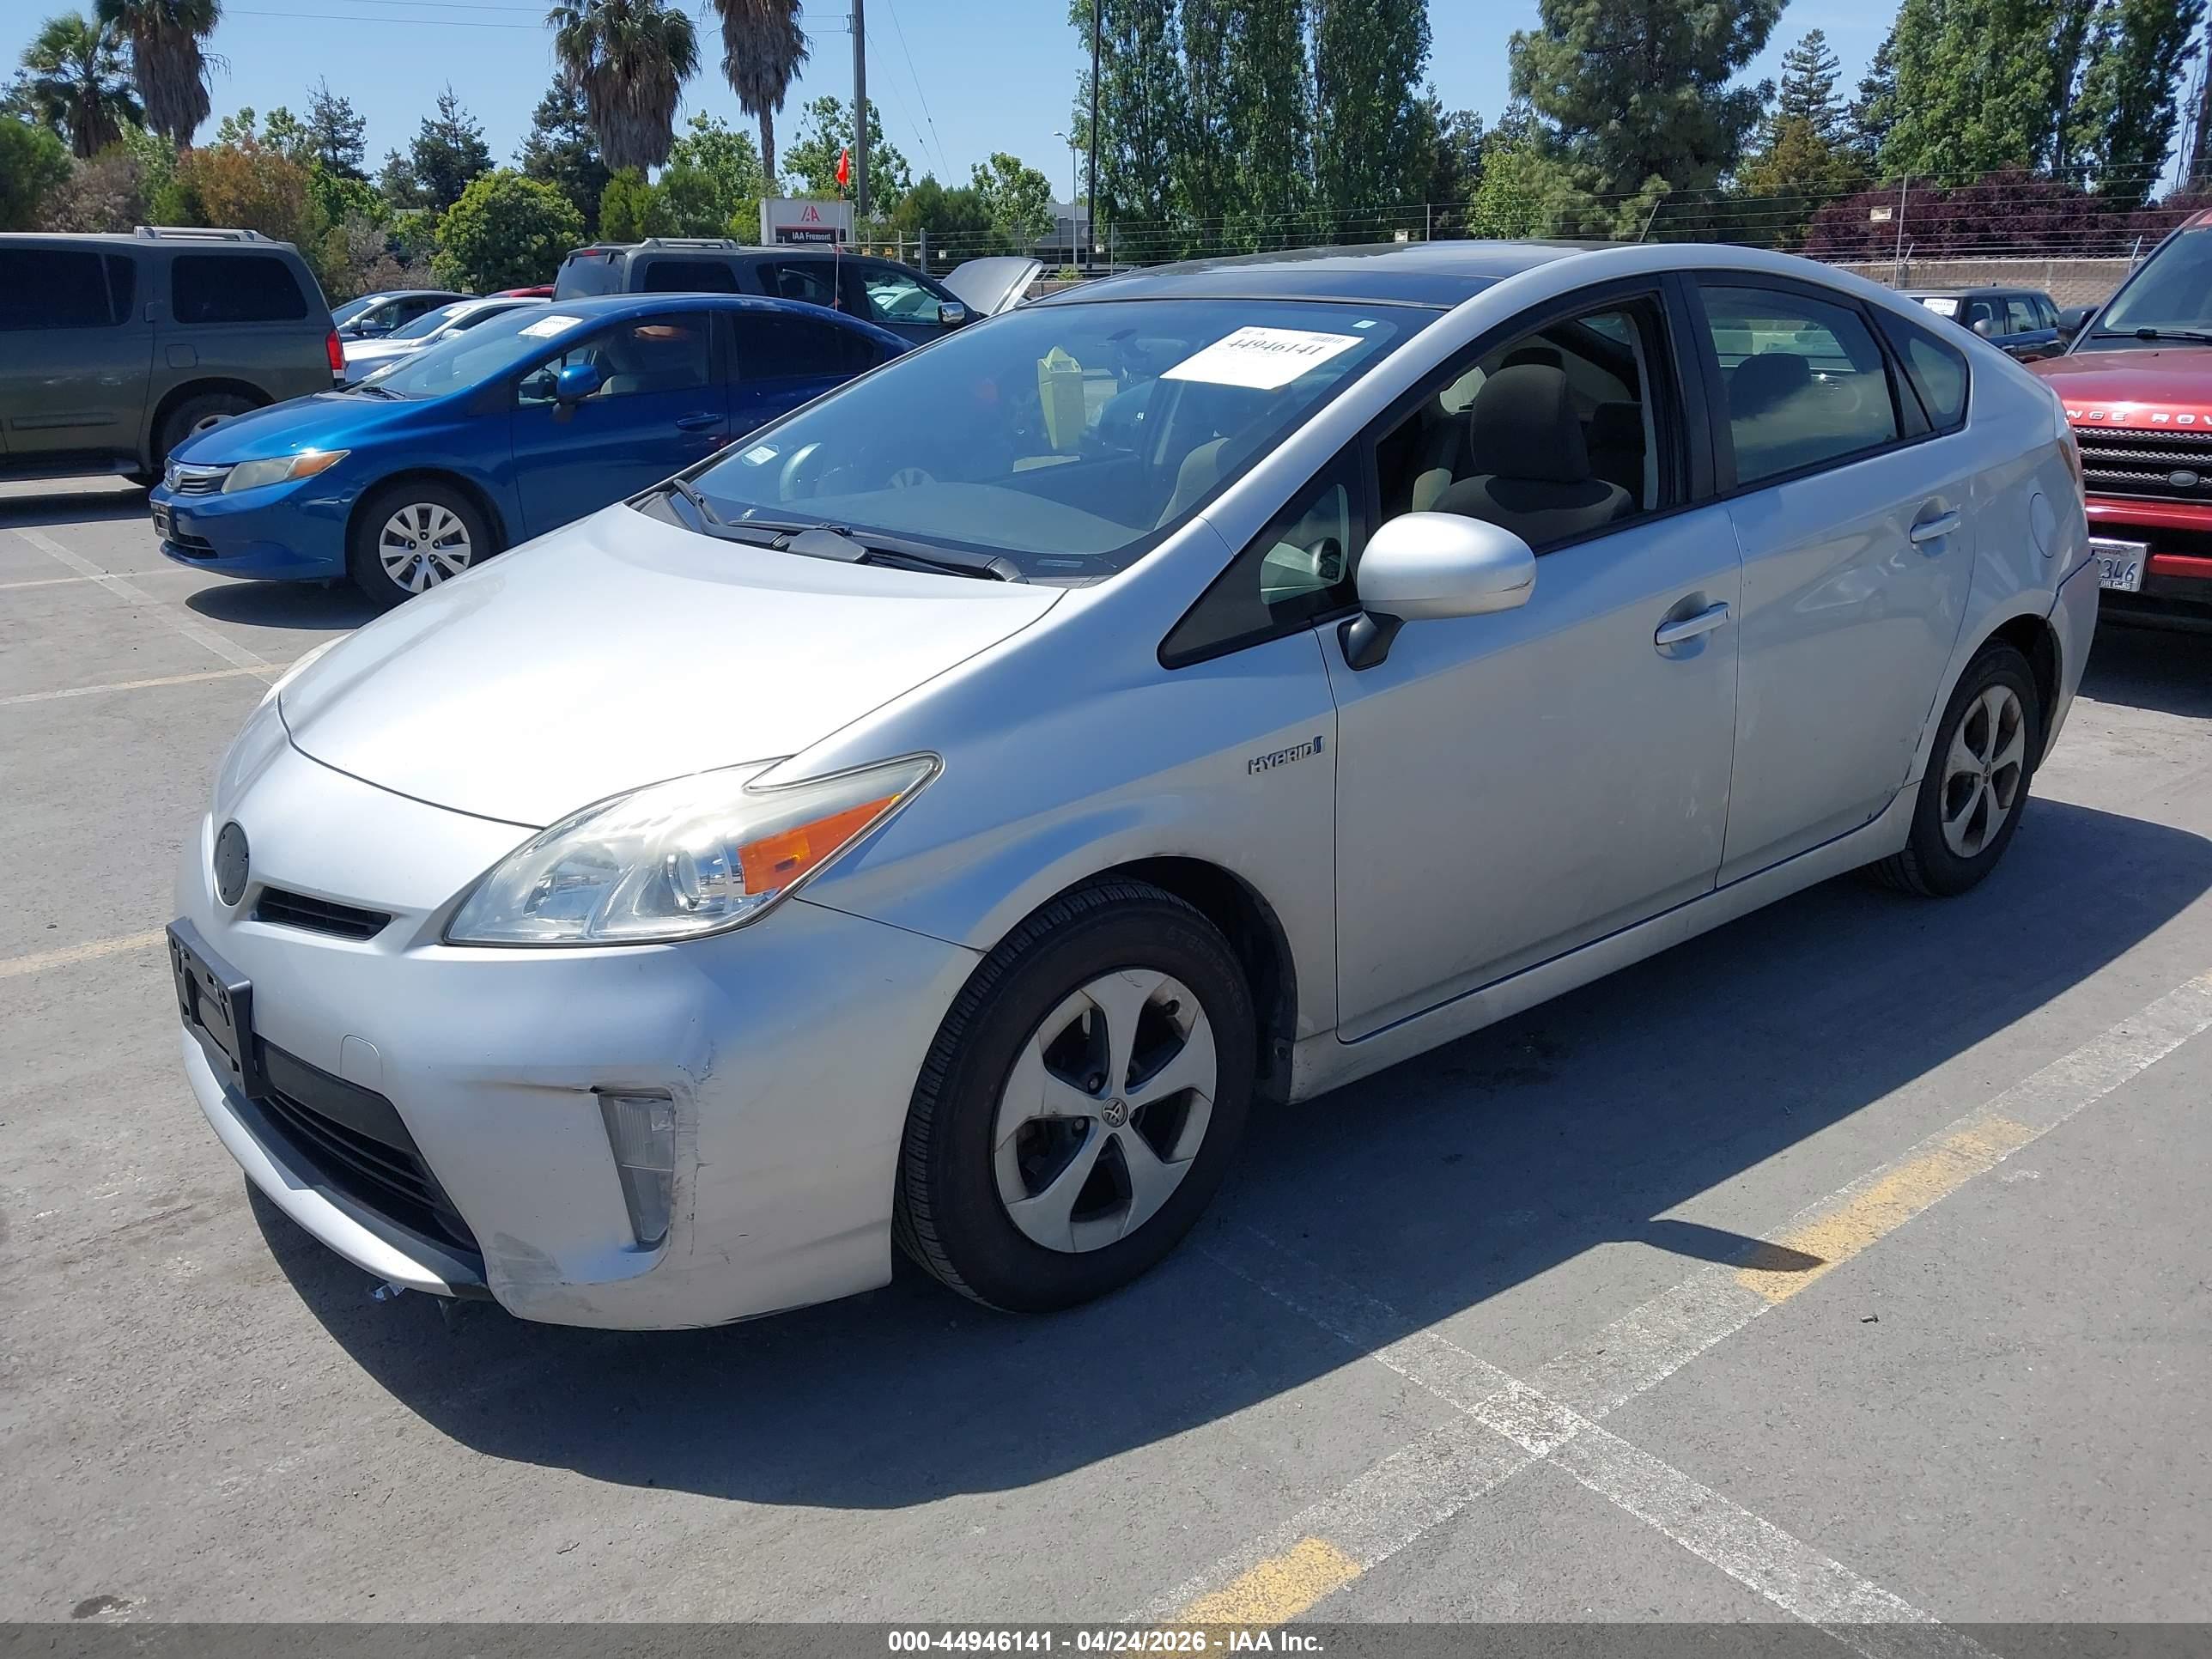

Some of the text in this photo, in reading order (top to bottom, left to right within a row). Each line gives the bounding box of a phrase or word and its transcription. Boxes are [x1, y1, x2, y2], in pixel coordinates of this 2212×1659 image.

[792, 231, 831, 240] IAA Fremont
[1228, 338, 1325, 355] 44946141
[2097, 558, 2137, 581] 346
[1248, 742, 1312, 775] HYBRID
